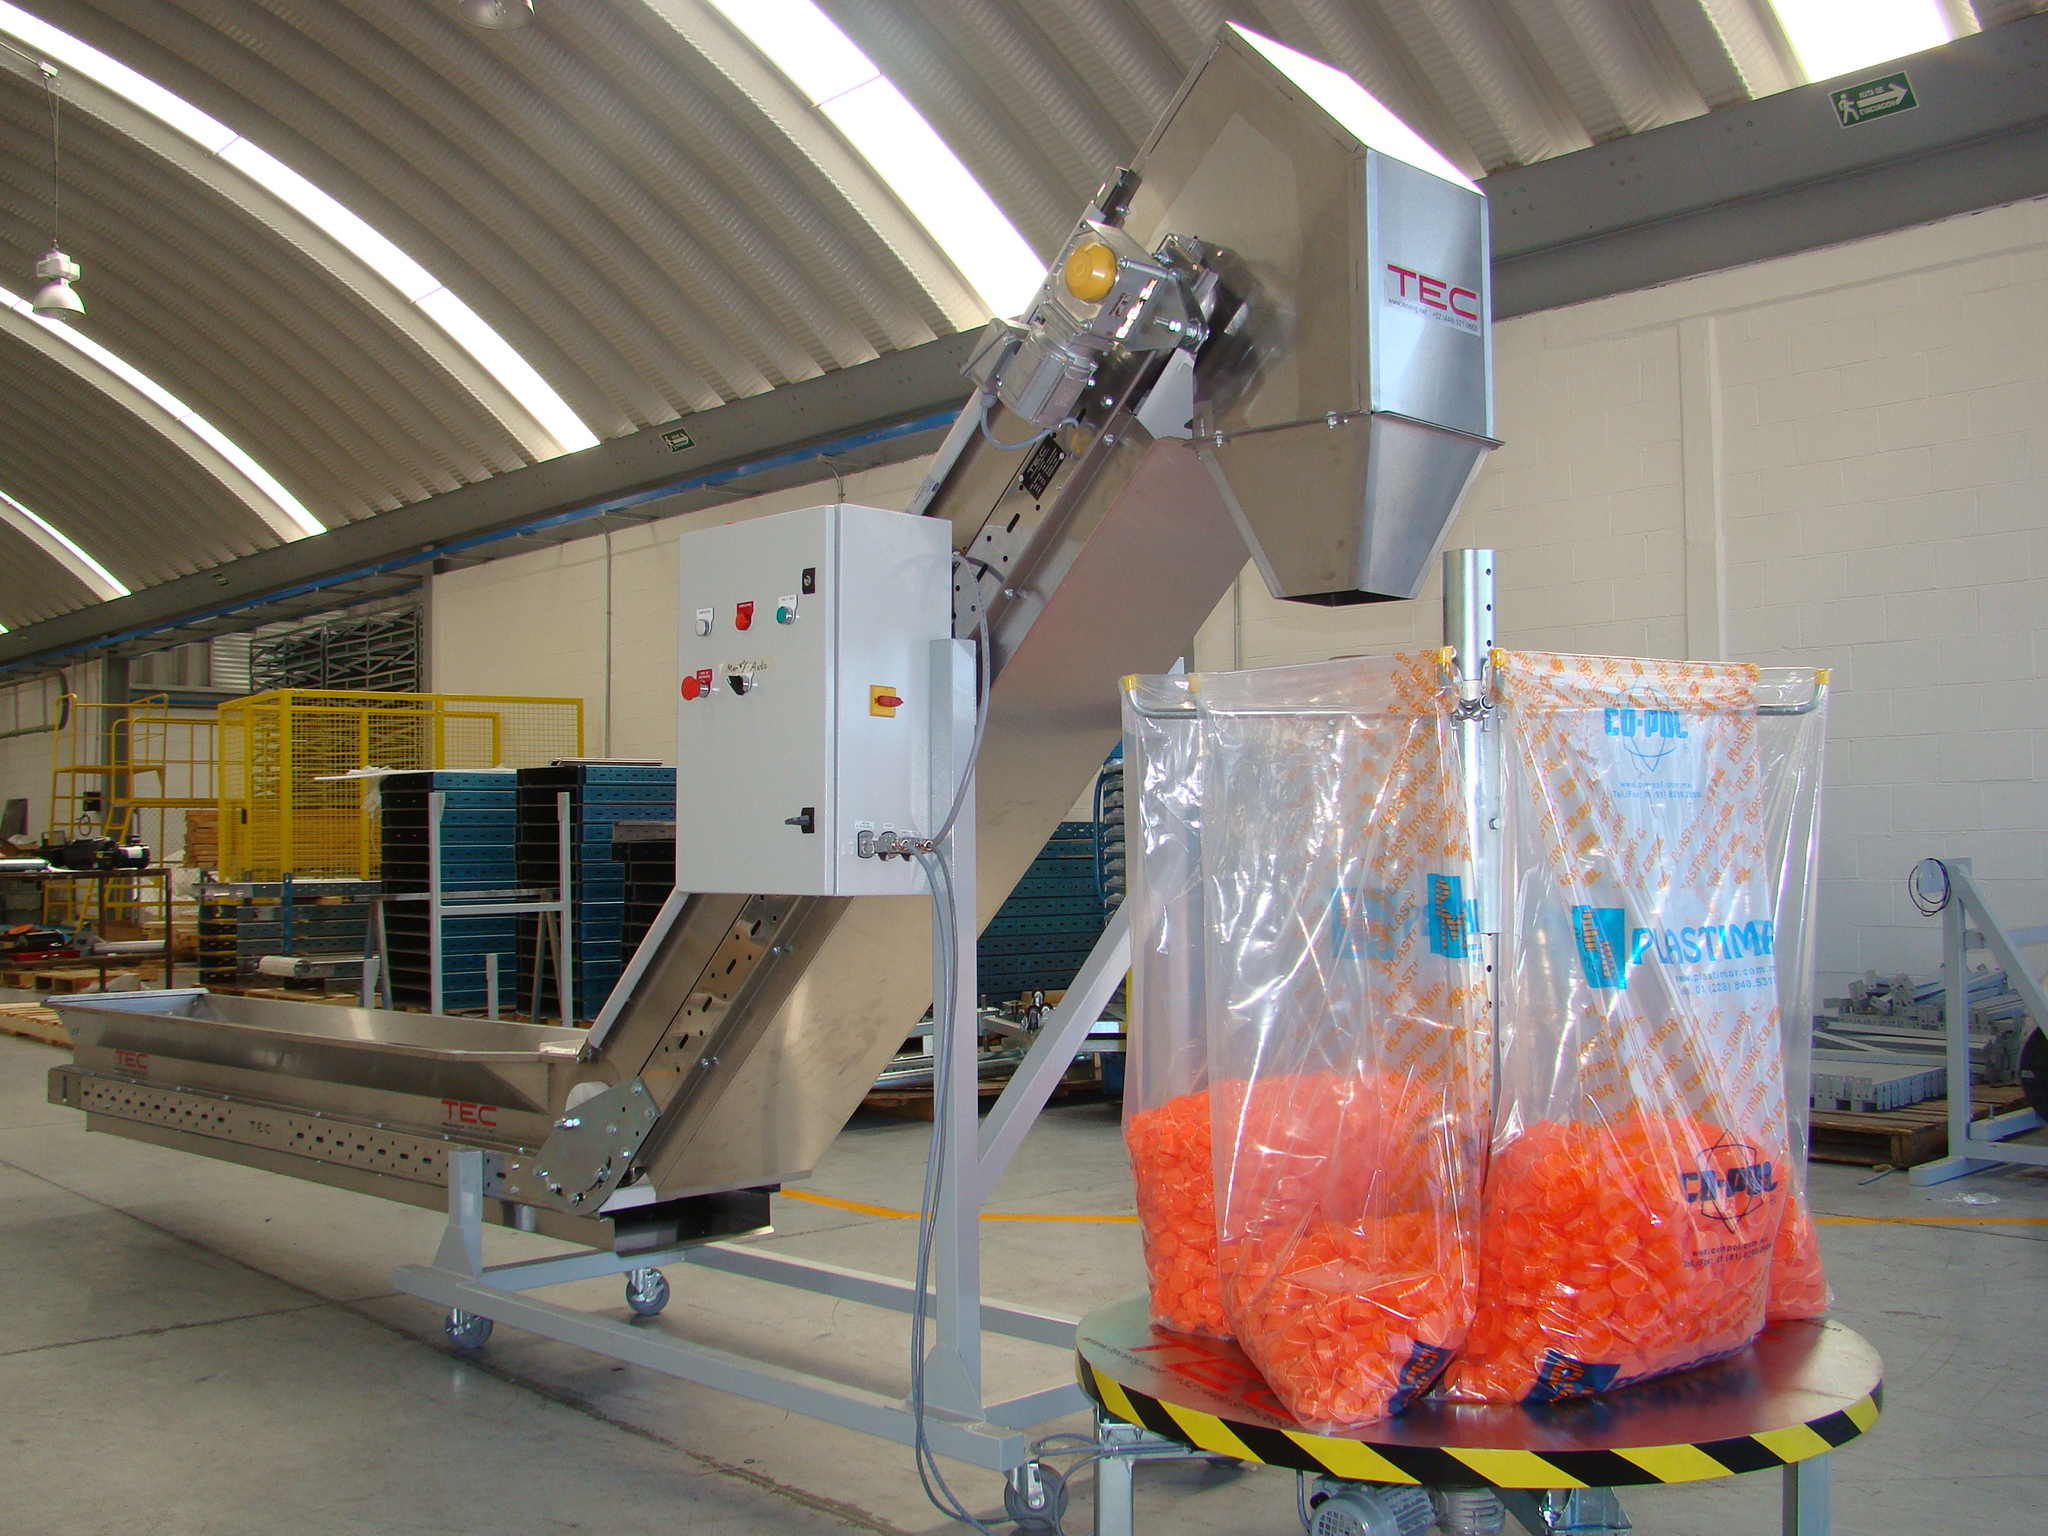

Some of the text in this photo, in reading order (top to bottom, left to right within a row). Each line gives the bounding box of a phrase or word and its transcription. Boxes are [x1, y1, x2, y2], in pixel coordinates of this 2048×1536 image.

[1387, 263, 1477, 321] TEC
[1604, 707, 1689, 739] CO-POL
[1695, 985, 1706, 994] 01
[1708, 982, 1732, 995] (228)
[115, 1050, 149, 1070] TEC
[441, 1099, 497, 1127] TEC
